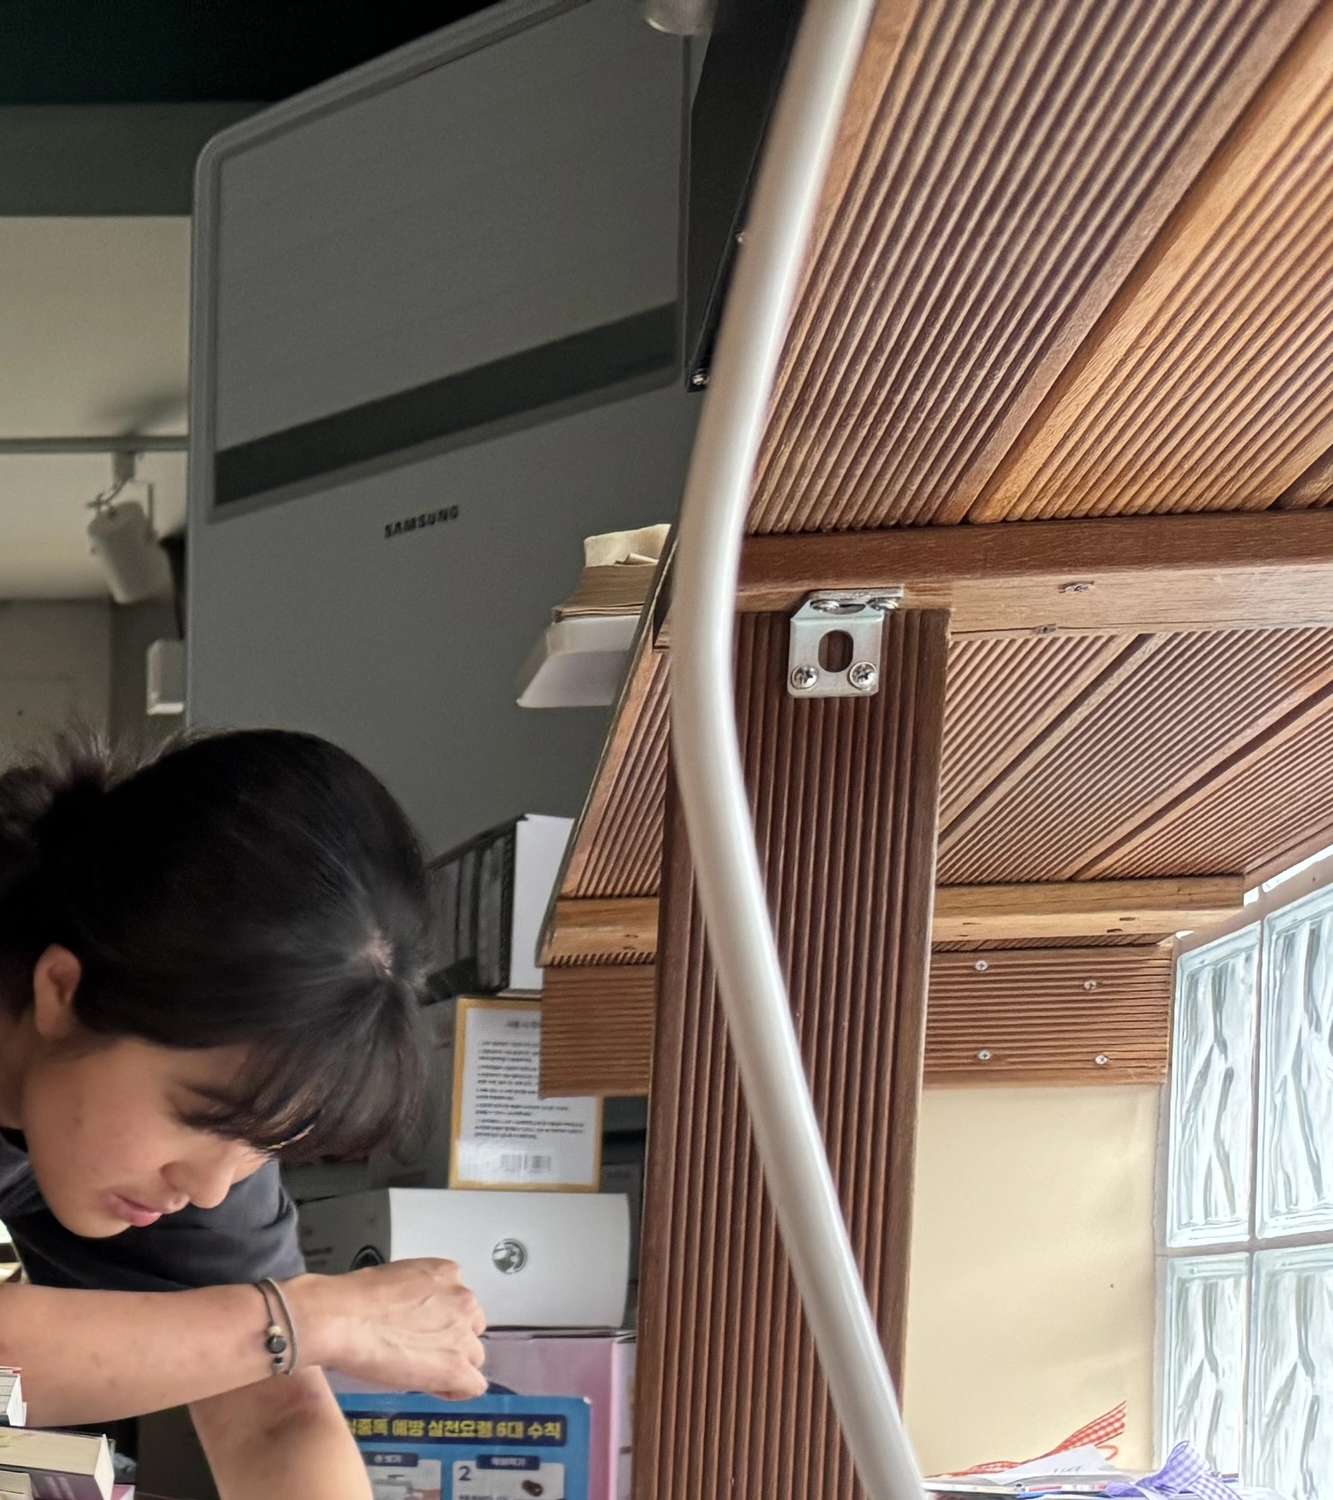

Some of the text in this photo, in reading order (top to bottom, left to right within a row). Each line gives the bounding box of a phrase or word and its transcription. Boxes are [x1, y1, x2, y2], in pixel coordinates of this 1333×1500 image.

[384, 504, 460, 539] SAMSUNG
[392, 1419, 426, 1436] 예방
[428, 1420, 493, 1438] 실천요령
[528, 1421, 563, 1440] 수칙
[458, 1466, 471, 1481] 2
